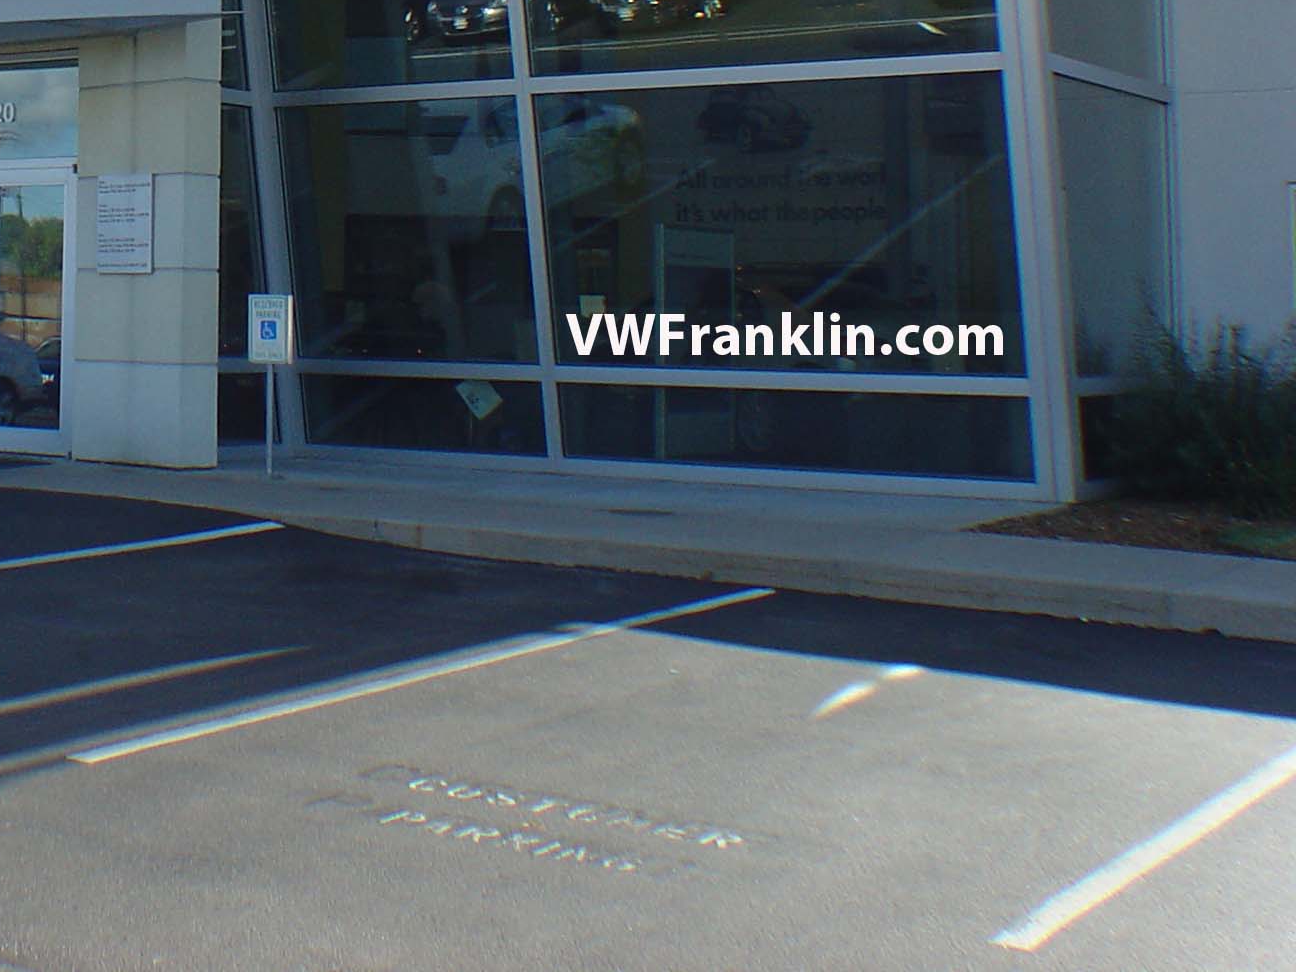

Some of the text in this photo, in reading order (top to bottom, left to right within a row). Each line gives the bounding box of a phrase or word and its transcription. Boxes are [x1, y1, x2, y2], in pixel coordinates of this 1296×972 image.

[676, 201, 704, 222] it's
[710, 200, 769, 222] what
[813, 197, 888, 226] people
